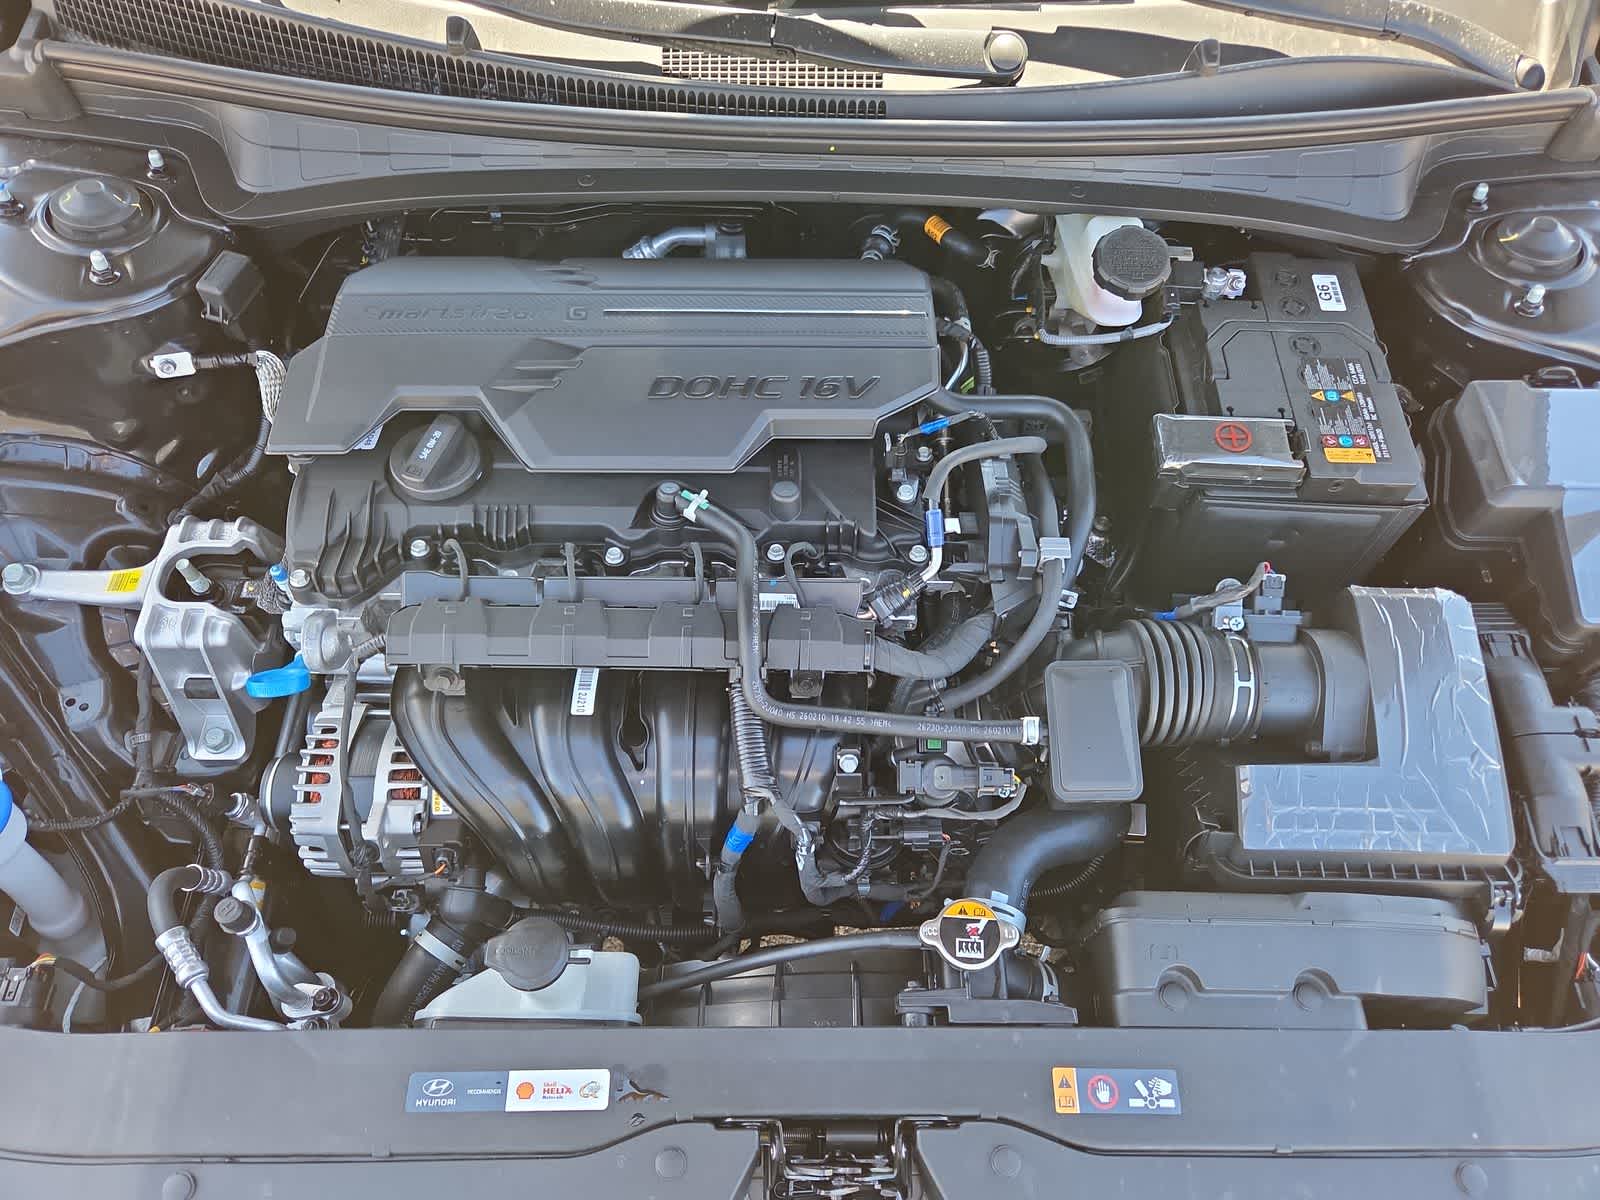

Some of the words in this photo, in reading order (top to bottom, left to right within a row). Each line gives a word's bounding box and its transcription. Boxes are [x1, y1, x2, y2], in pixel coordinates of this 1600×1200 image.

[1317, 285, 1332, 301] G6
[566, 304, 588, 321] G
[648, 375, 790, 400] DOHC
[799, 375, 881, 400] 16V
[543, 1087, 573, 1095] HELIX
[415, 1098, 456, 1107] HYUNDAI
